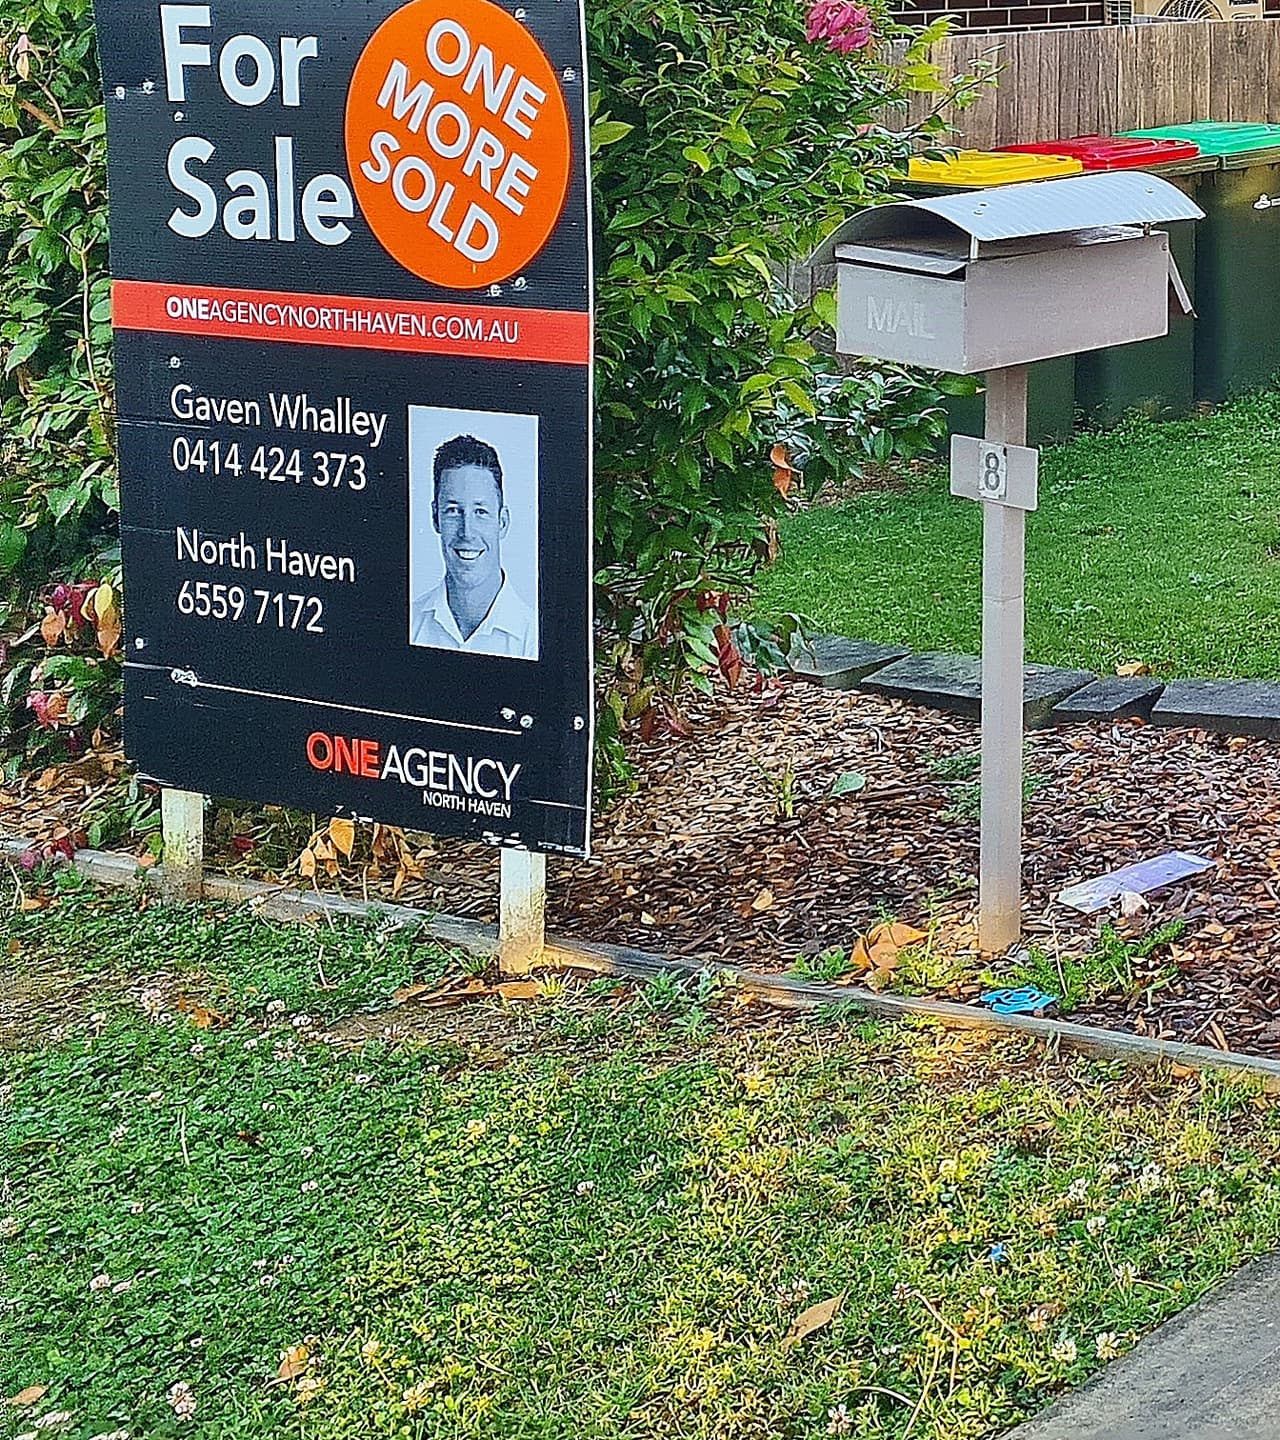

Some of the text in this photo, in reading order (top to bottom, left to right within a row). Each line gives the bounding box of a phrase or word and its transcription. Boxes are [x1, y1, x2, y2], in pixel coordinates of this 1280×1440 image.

[160, 4, 318, 107] For
[426, 19, 546, 140] ONE
[377, 59, 538, 217] MORE
[166, 136, 354, 246] Sale
[361, 131, 499, 263] SOLD
[166, 296, 519, 344] ONEAGENCYNORTHHAVEN.COM.AU
[866, 295, 936, 340] MAIL
[170, 383, 387, 446] Gaven Whalley
[172, 437, 367, 490] 0414 424 373
[984, 452, 1000, 491] 8
[176, 526, 355, 583] North Haven
[177, 580, 324, 633] 6559 7172
[423, 791, 511, 819] NORTH HAVEN
